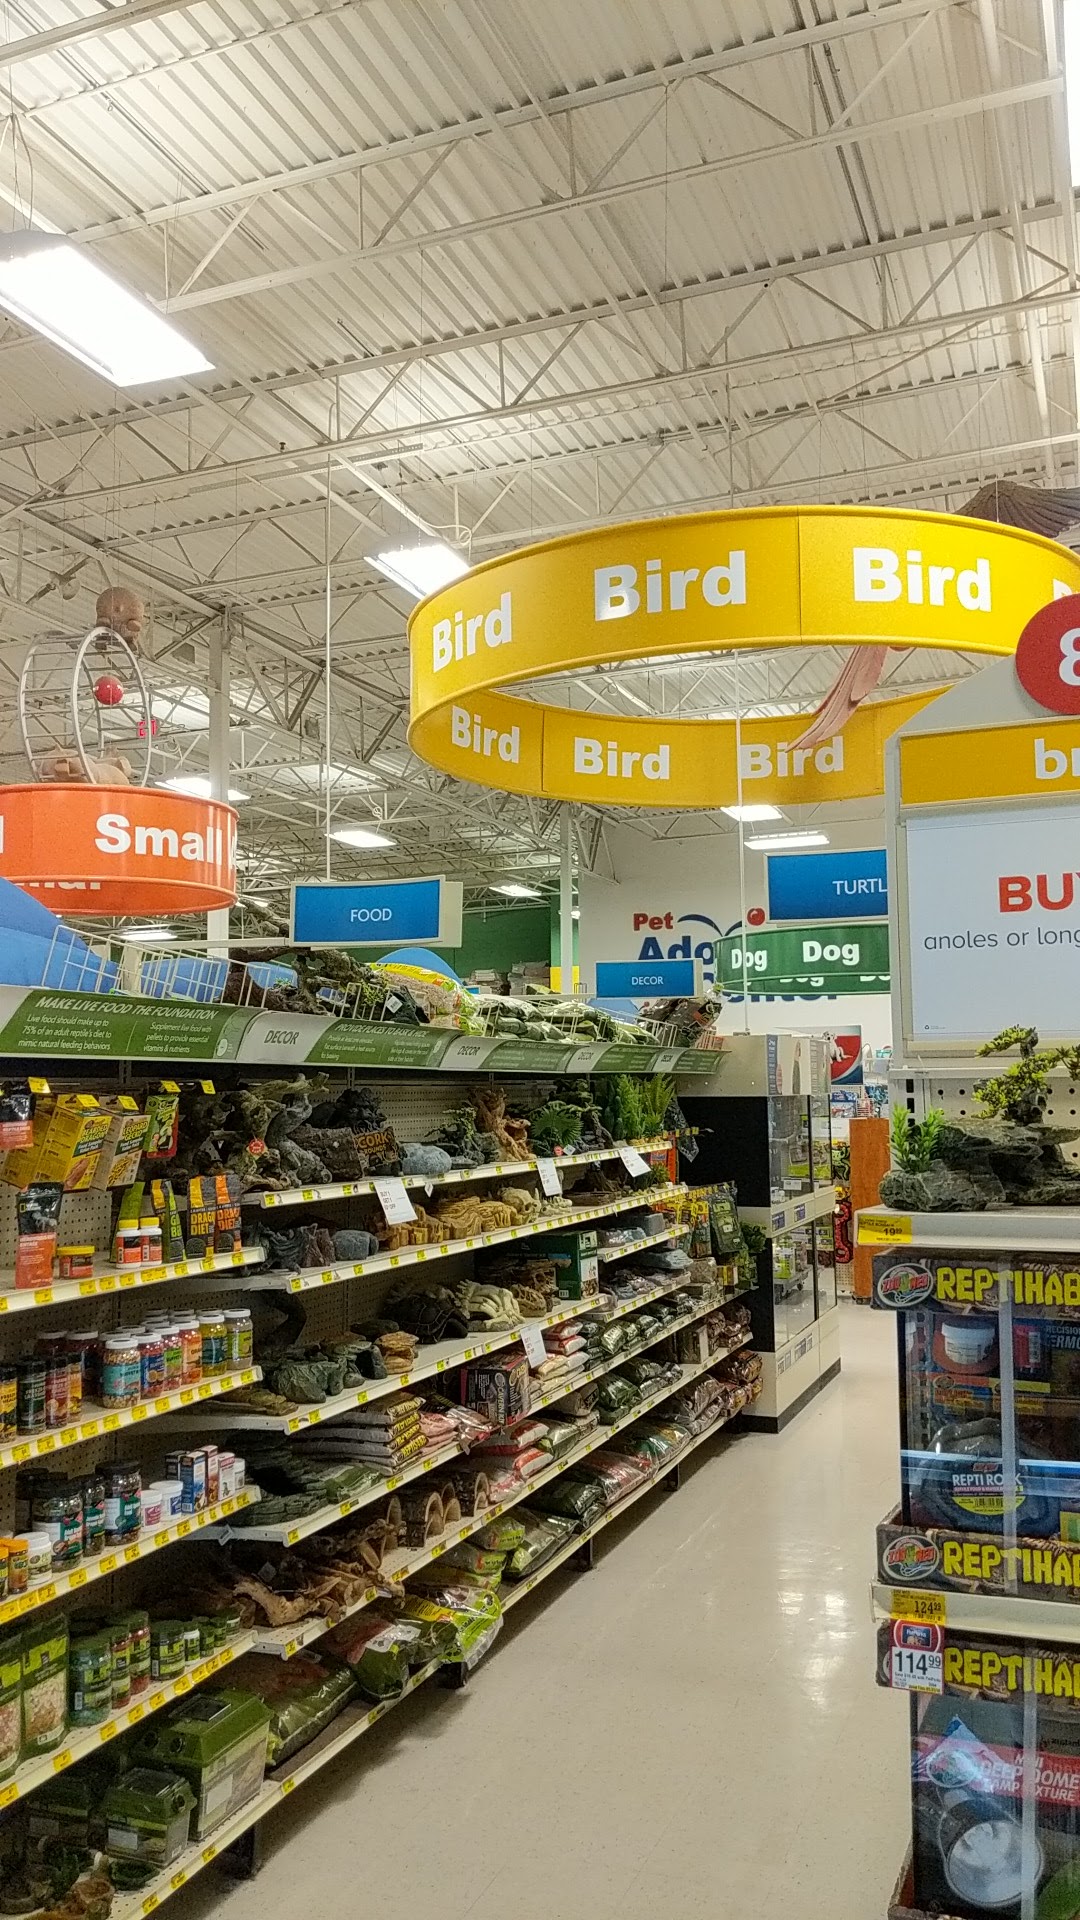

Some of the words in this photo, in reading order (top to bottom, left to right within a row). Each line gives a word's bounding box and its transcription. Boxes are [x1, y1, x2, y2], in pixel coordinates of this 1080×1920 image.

[594, 550, 746, 621] Bird
[852, 547, 991, 612] Bird
[433, 592, 512, 672] Bird
[452, 705, 520, 763] Bird
[574, 737, 670, 780] Bird
[741, 736, 844, 779] Bird
[95, 813, 222, 866] Small
[998, 872, 1080, 913] BU
[350, 907, 392, 923] FOOD
[633, 911, 674, 932] Pet
[924, 930, 998, 950] anoles
[1006, 932, 1029, 947] or
[731, 949, 768, 972] Dog
[802, 940, 860, 966] Dog
[631, 975, 664, 986] DECOR
[35, 996, 73, 1010] MAKE
[72, 998, 100, 1012] LIVE
[97, 1002, 133, 1014] FOOD
[132, 1005, 155, 1016] THE
[151, 1006, 219, 1020] FOUNDATION
[27, 1014, 40, 1022] Live
[40, 1014, 55, 1024] food
[56, 1015, 77, 1024] should
[77, 1017, 92, 1026] make
[150, 1022, 180, 1032] Supplement
[22, 1026, 38, 1034] 75%
[37, 1026, 46, 1035] of
[54, 1028, 70, 1036] adult
[70, 1028, 92, 1038] reptile's
[92, 1030, 104, 1038] diet
[105, 1030, 112, 1038] to
[264, 1030, 300, 1046] DECOR
[38, 1040, 60, 1048] natural
[60, 1039, 83, 1051] feeding
[83, 1041, 111, 1050] behaviors
[457, 1046, 480, 1056] DECOR
[358, 1131, 390, 1149] CORK
[190, 1223, 209, 1236] DIET
[217, 1218, 236, 1231] DIET
[936, 1267, 1080, 1306] REPTIHAB
[952, 1474, 984, 1486] REPTI
[986, 1473, 1022, 1486] ROK
